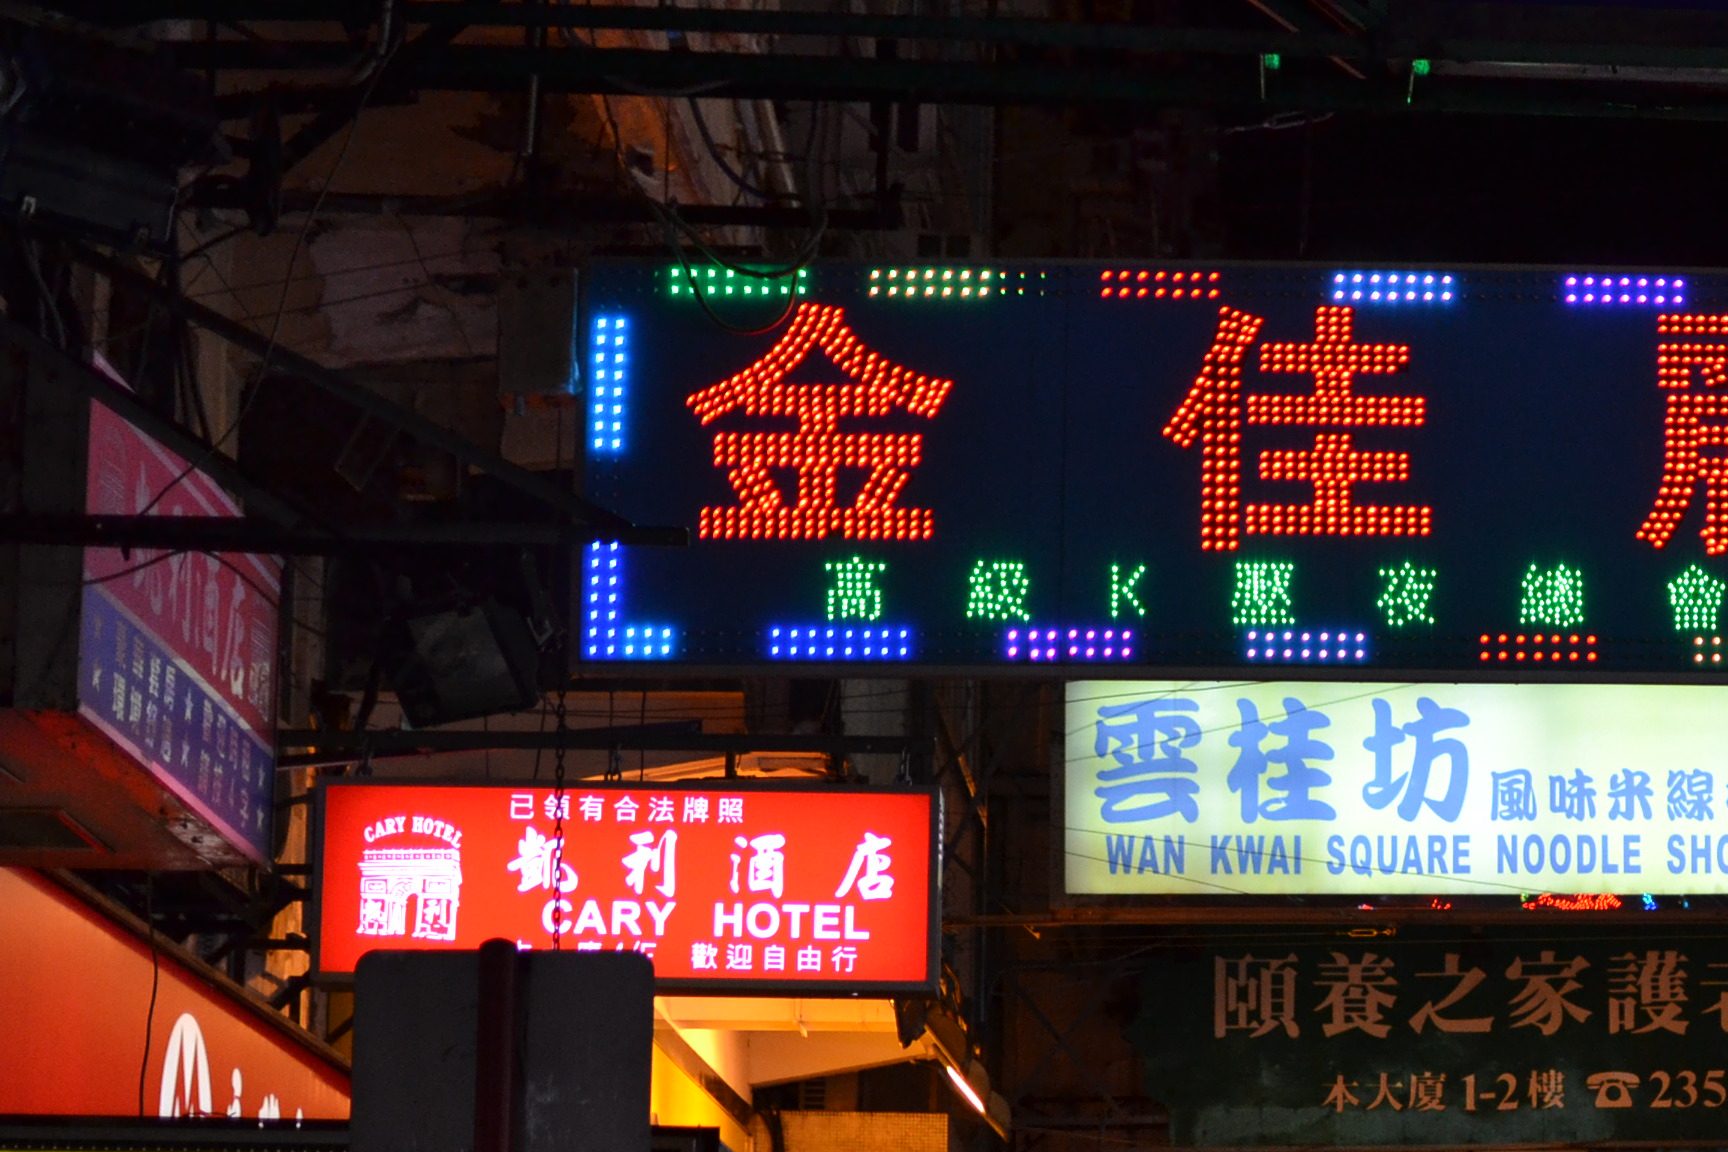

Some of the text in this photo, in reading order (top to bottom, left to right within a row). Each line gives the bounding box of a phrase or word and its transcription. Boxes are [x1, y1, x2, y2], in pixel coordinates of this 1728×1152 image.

[1094, 696, 1472, 824] 雲桂坊
[364, 816, 464, 849] CARY HOTEL
[1105, 834, 1186, 876] WAN
[1210, 834, 1303, 876] KWAI
[1326, 835, 1472, 878] SQUARE
[1498, 835, 1643, 876] NOODLE
[542, 901, 872, 941] CARY HOTEL
